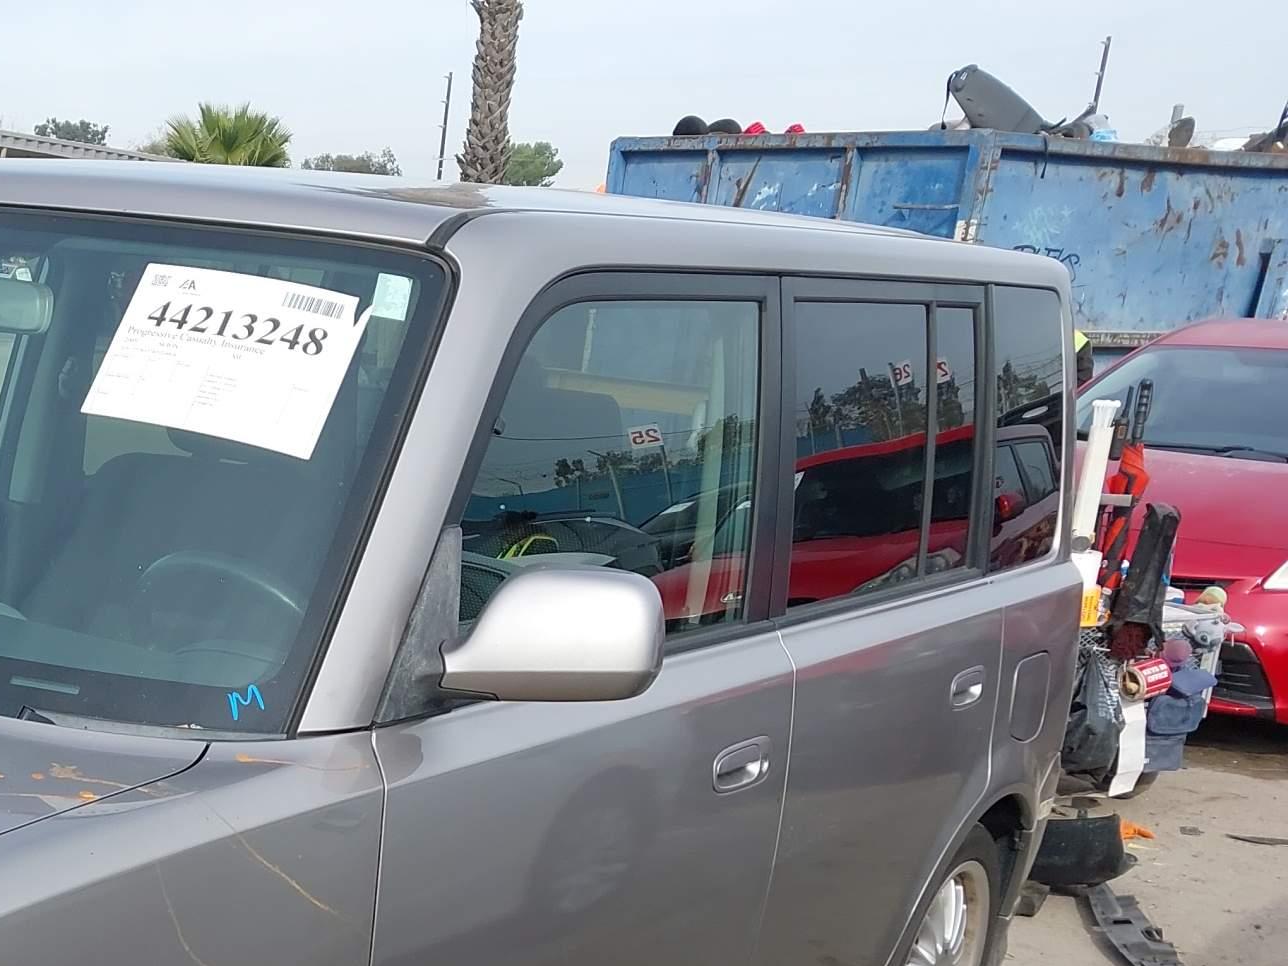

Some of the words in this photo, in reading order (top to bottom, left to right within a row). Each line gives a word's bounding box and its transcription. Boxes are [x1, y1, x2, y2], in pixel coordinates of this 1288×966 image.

[127, 324, 178, 341] Progressive
[179, 332, 218, 347] Casualty
[220, 338, 267, 355] Insurance
[147, 300, 329, 356] 44213248
[226, 684, 265, 720] M
